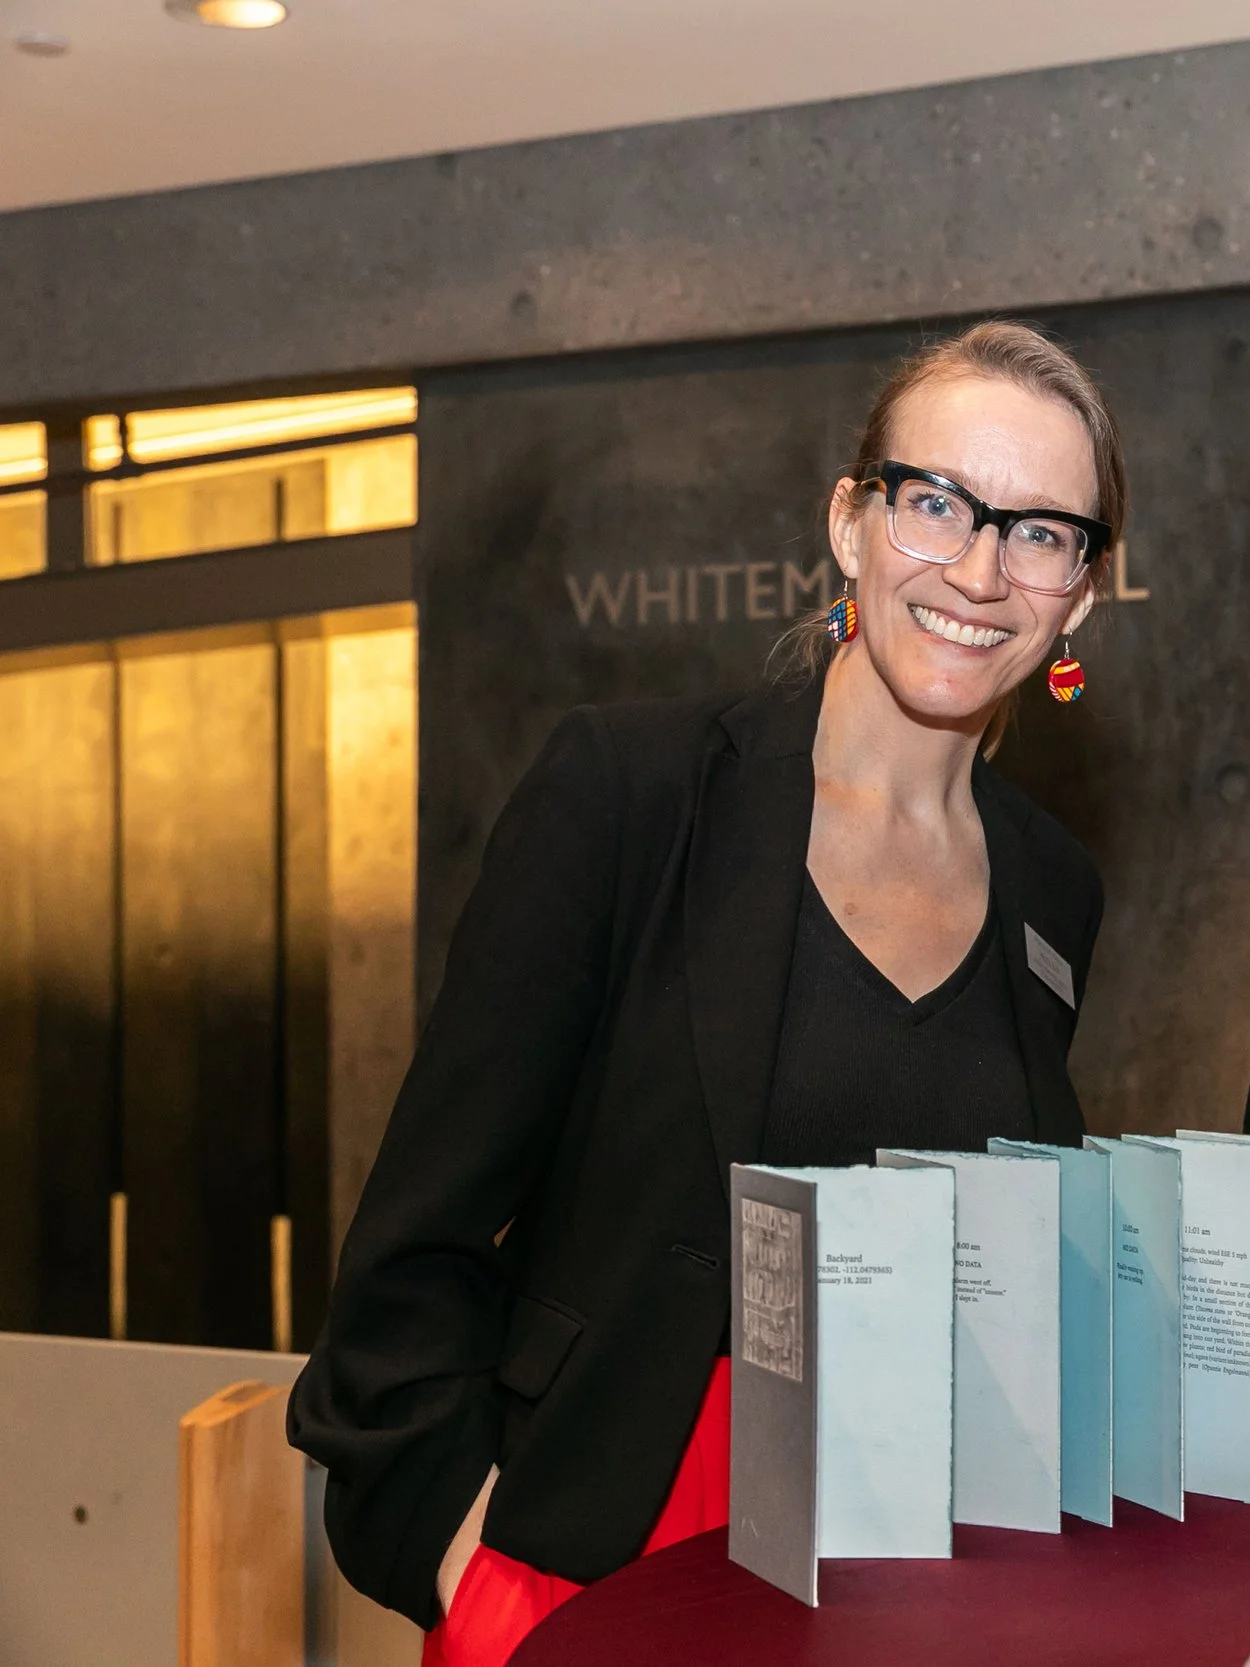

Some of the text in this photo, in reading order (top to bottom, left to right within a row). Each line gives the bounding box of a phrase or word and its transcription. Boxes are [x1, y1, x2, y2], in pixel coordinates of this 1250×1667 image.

[564, 559, 830, 627] WHITEM
[1184, 1226, 1200, 1234] 11:01
[826, 1254, 862, 1264] Backyard
[1236, 1252, 1248, 1260] mph
[1199, 1257, 1224, 1267] Unhealthy
[817, 1266, 840, 1274] 78302,
[843, 1276, 854, 1284] 18,
[1208, 1278, 1222, 1286] there
[1219, 1299, 1236, 1307] section
[1232, 1320, 1244, 1328] from
[1210, 1326, 1234, 1337] beginning
[1226, 1338, 1244, 1346] Within
